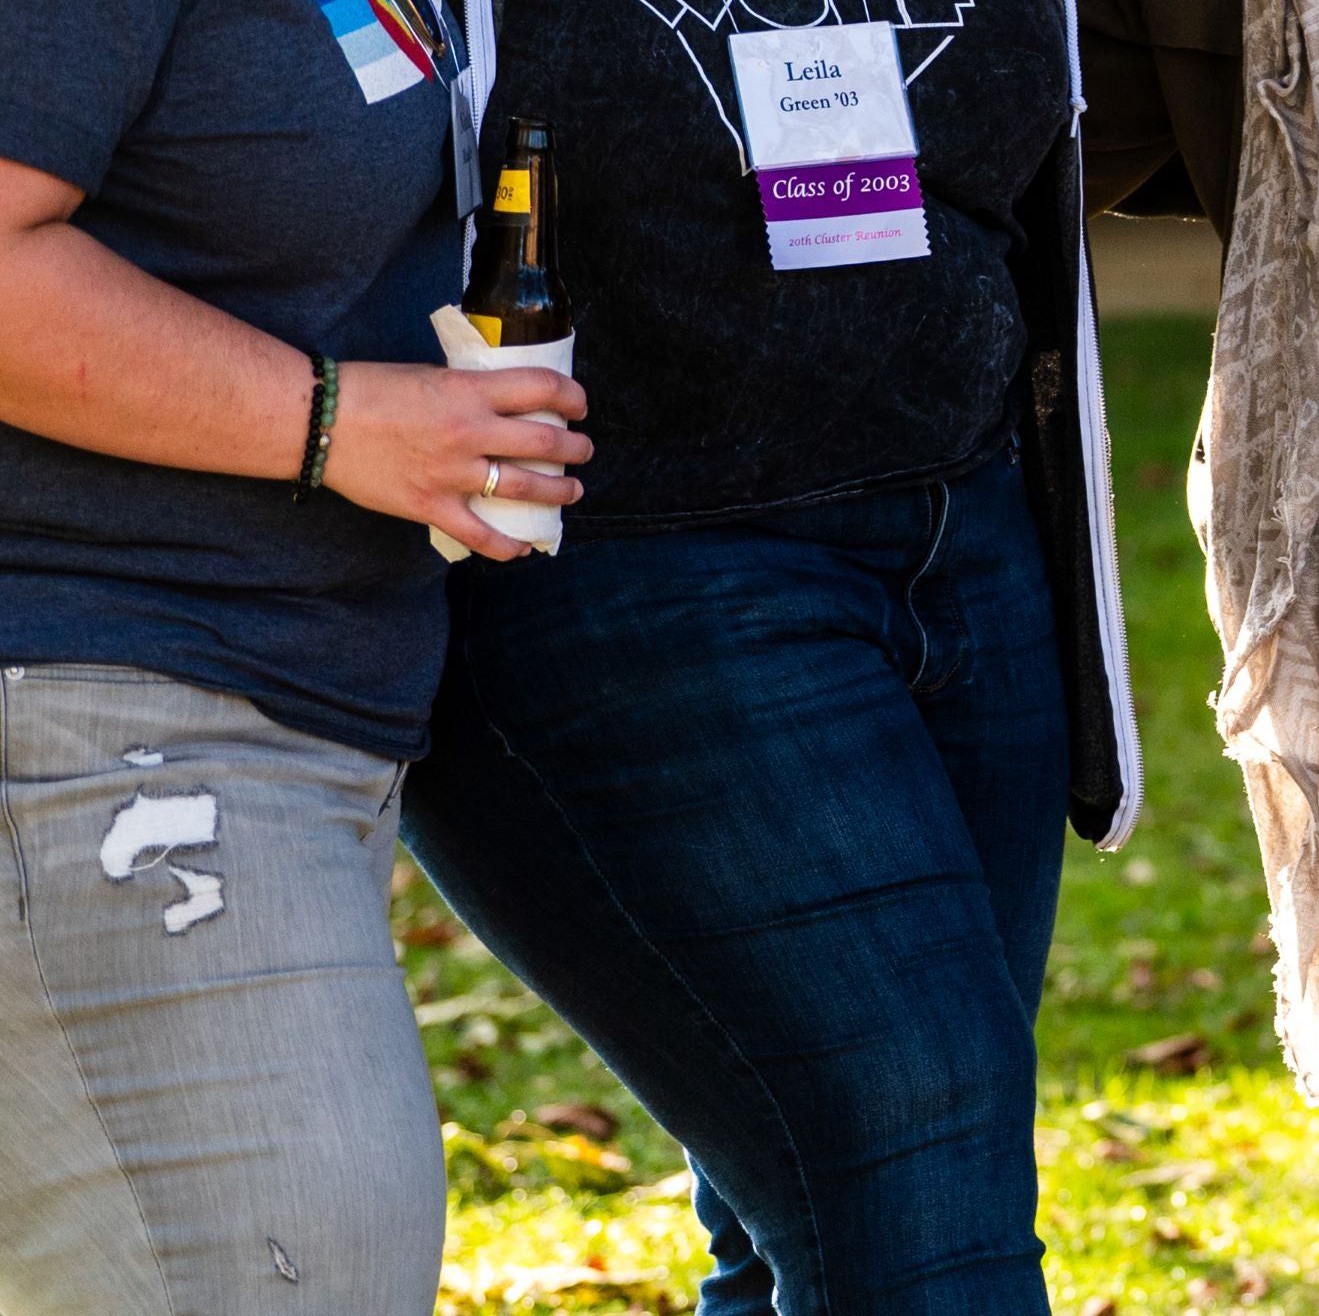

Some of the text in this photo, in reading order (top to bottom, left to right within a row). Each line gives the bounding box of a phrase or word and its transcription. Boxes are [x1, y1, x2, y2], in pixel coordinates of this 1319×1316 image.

[784, 59, 842, 82] Leila
[780, 91, 859, 112] Green '03
[773, 172, 910, 201] Class of 2003
[789, 227, 902, 247] 20th Cluster Reunion
